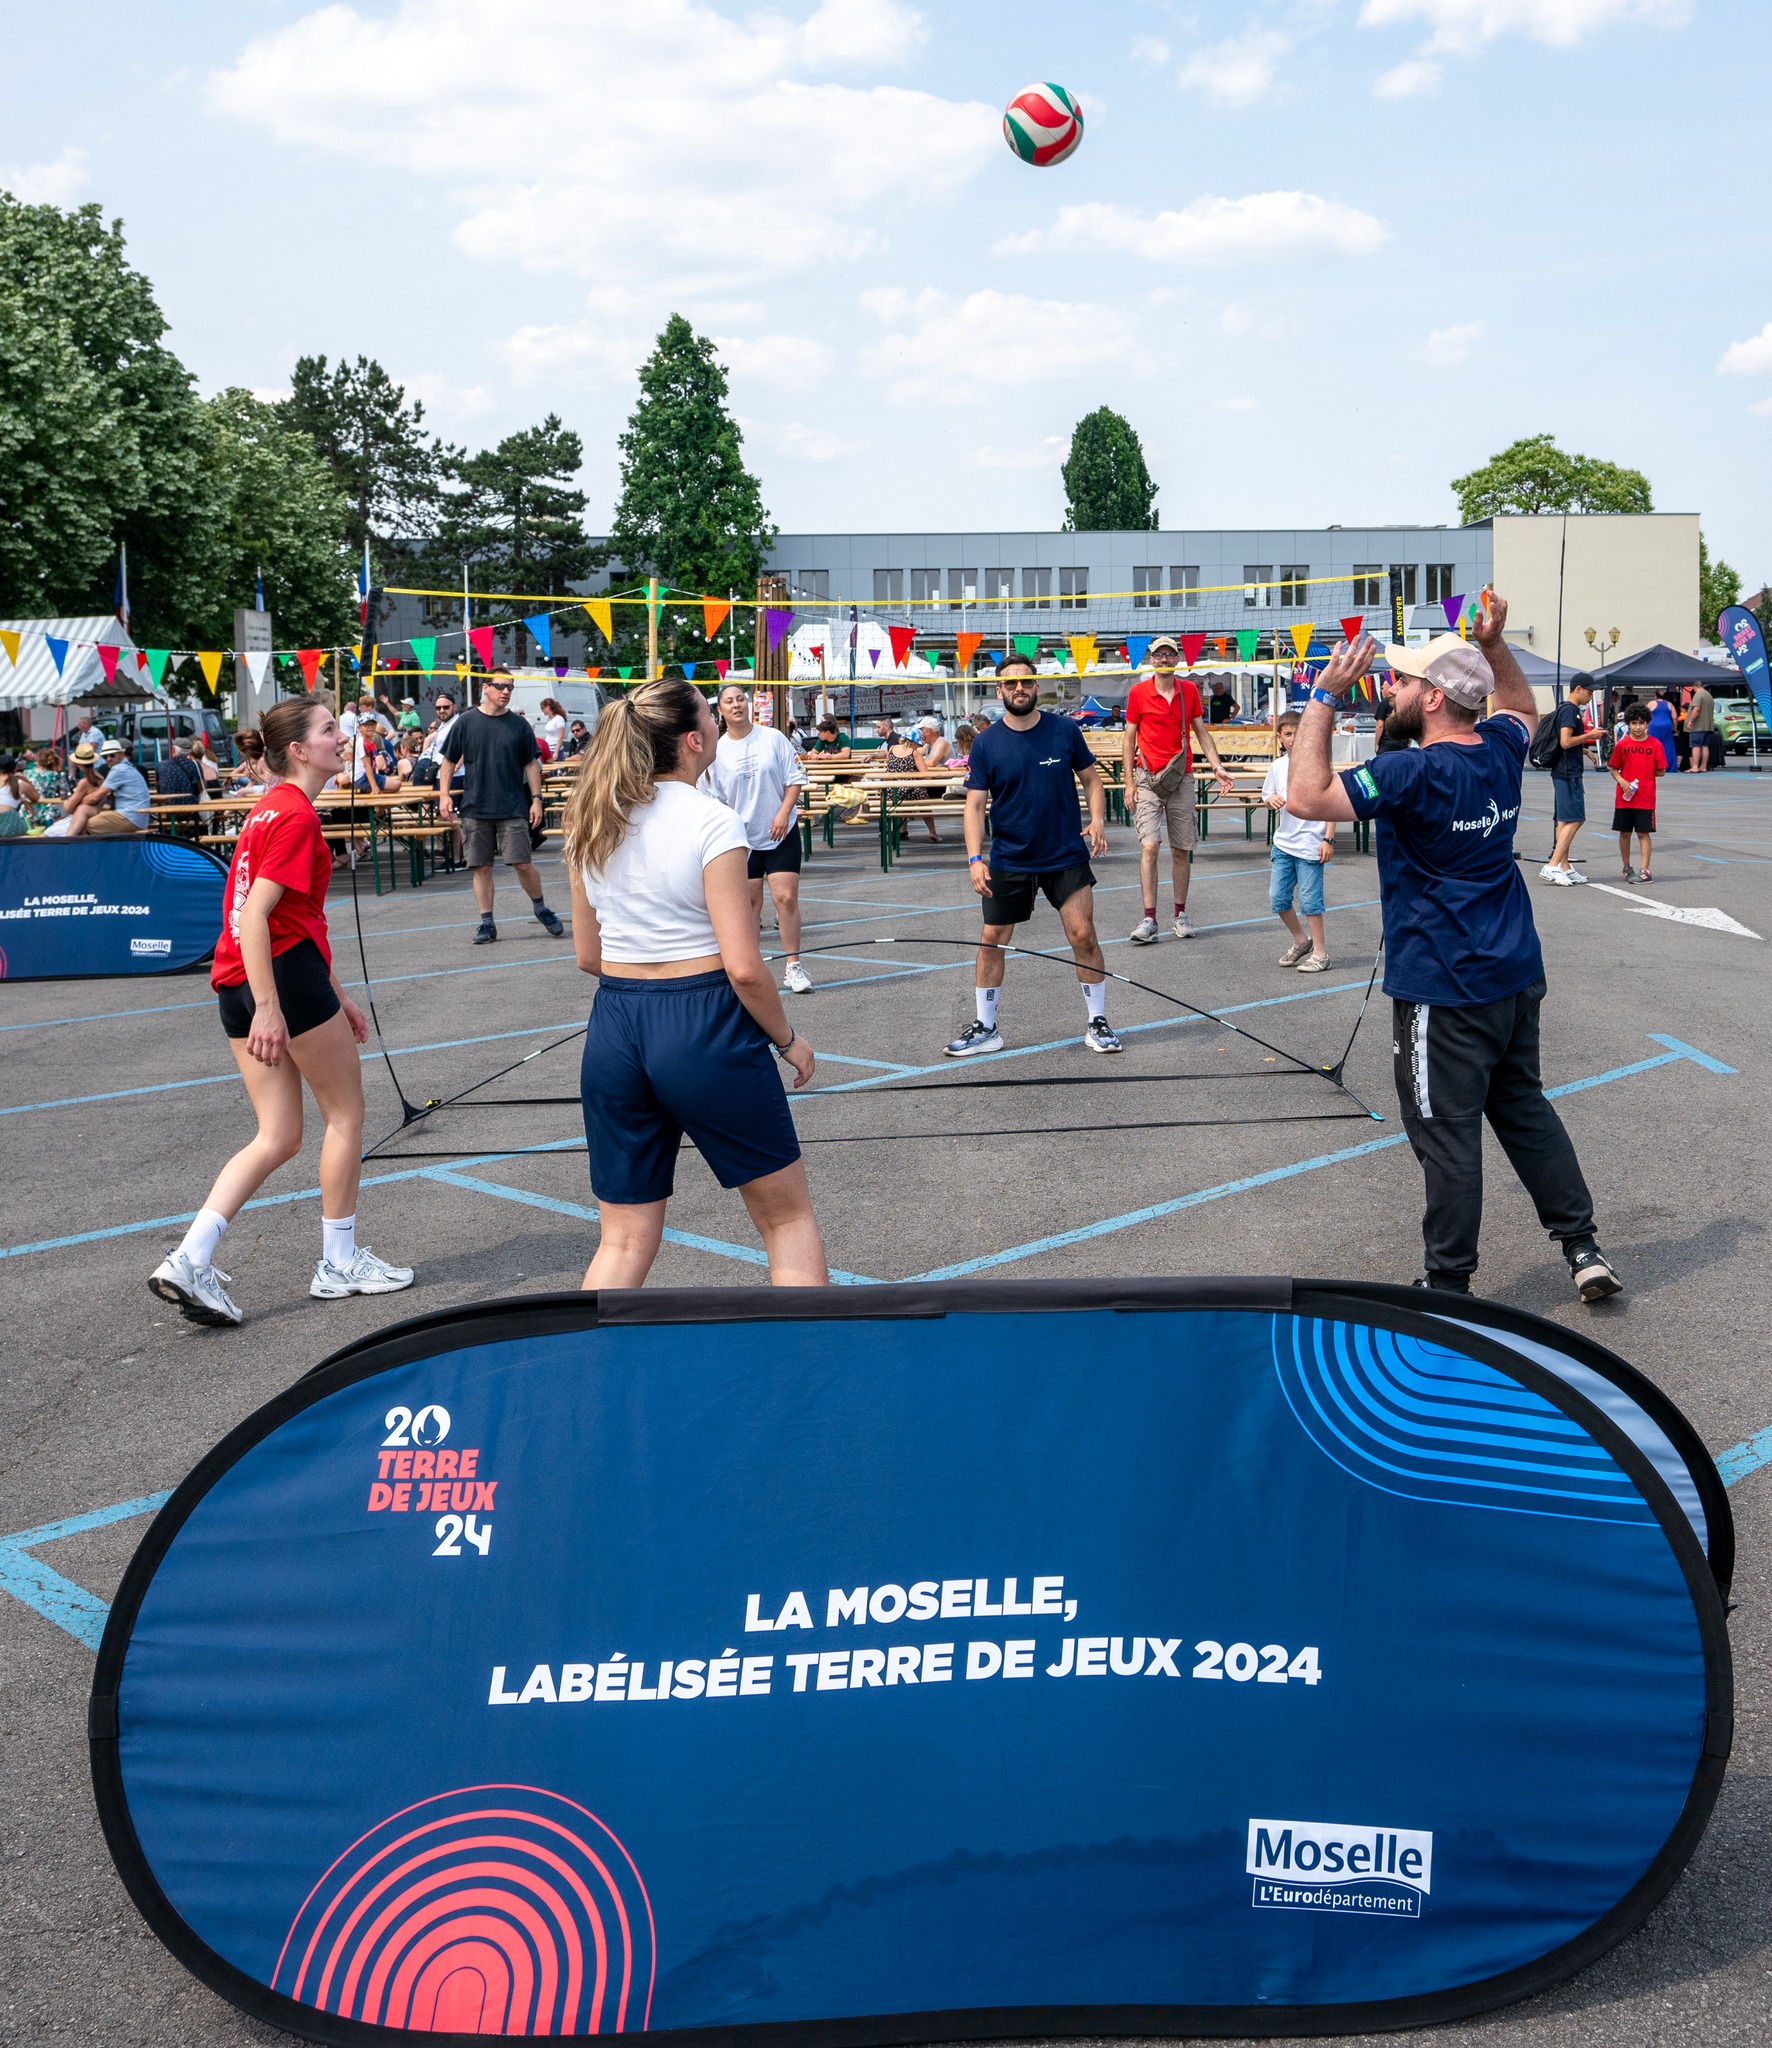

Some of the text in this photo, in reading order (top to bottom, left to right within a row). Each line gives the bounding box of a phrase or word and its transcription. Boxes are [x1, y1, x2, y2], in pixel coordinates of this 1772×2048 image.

[1396, 596, 1404, 636] SANDEVER
[1624, 746, 1653, 755] HUGO
[0, 905, 150, 919] LISÉE TERRE DE JEUX 2024
[24, 894, 98, 906] LA MOSELLE,
[132, 941, 169, 950] Moselle
[381, 1404, 451, 1446] 20
[377, 1448, 480, 1479] TERRE
[367, 1481, 498, 1512] DE JEUX
[431, 1514, 493, 1556] 24
[744, 1576, 1078, 1632] LA MOSELLE,
[487, 1637, 1322, 1705] LABÉLISÉE TERRE DE JEUX 2024
[1254, 1827, 1423, 1879] Moselle
[1260, 1886, 1413, 1911] L'Eurodépartement
